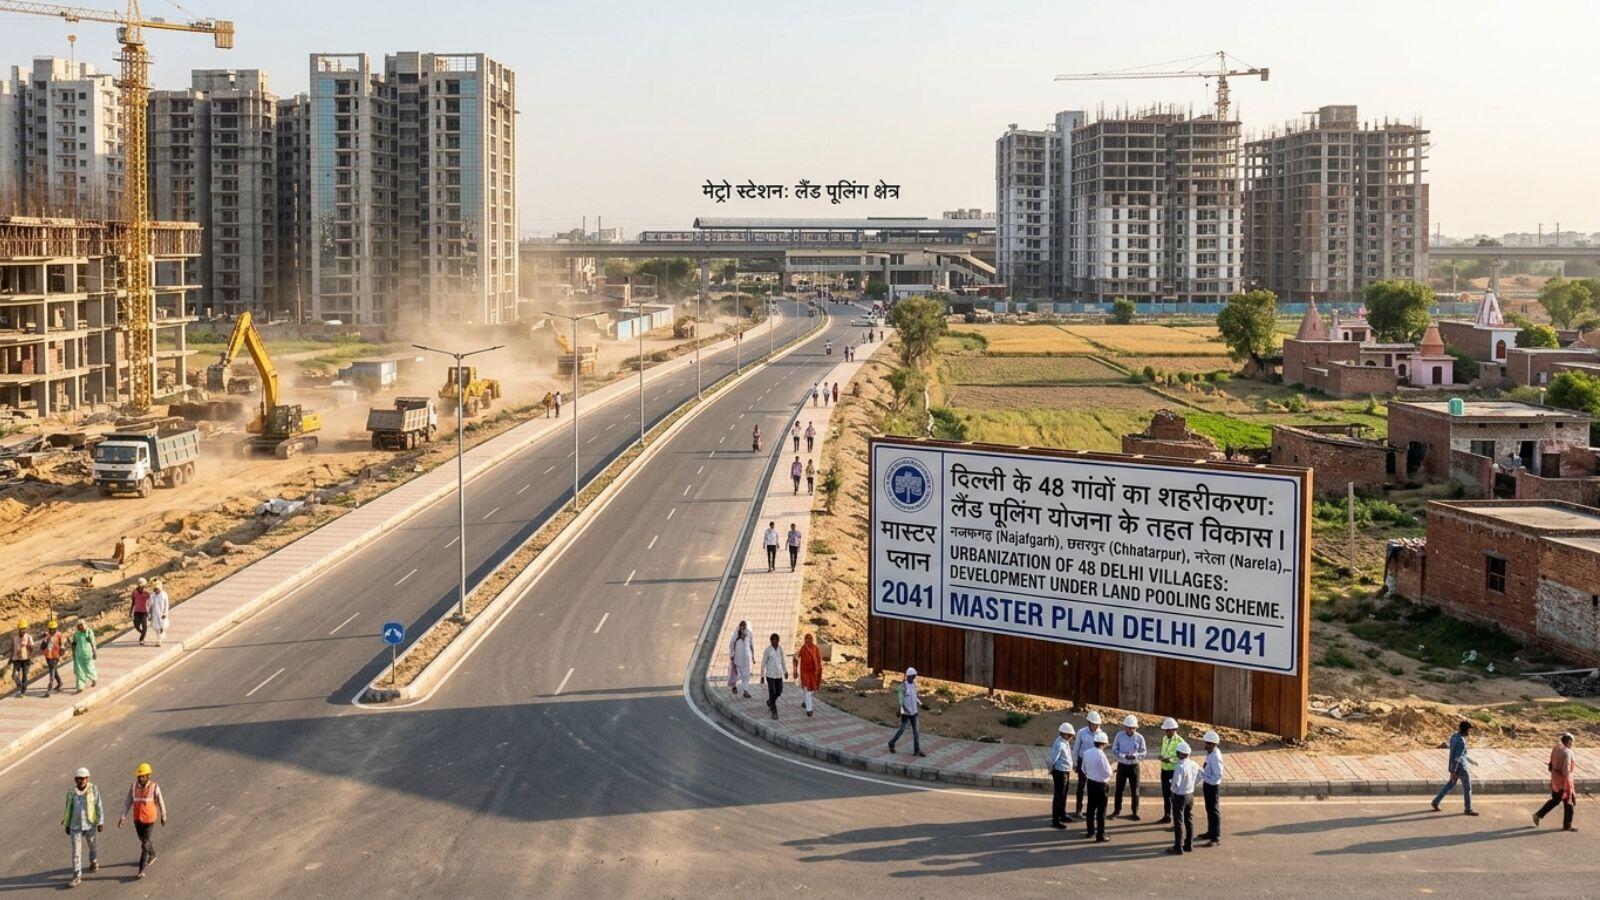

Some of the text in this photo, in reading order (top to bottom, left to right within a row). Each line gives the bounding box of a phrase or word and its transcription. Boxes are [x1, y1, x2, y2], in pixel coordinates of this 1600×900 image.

[1013, 468, 1032, 493] के
[1038, 477, 1064, 497] 48
[1071, 475, 1116, 502] गांवों
[1122, 484, 1151, 505] का
[1158, 483, 1274, 516] शहरीकरण:
[881, 521, 937, 543] मास्टर
[951, 492, 983, 518] लैंड
[989, 497, 1042, 528] पूलिंग
[1048, 502, 1112, 532] योजना
[1118, 508, 1140, 534] के
[1146, 517, 1193, 541] तहत
[1200, 516, 1273, 549] विकास
[886, 549, 932, 573] प्लान
[950, 545, 1228, 592] URBANIZATION OF 48 DELHI VILLAGES:
[996, 529, 1063, 550] (Najafgarh),
[1109, 541, 1190, 565] (Chhatarpur),
[882, 579, 933, 609] 2041
[950, 564, 1285, 620] DEVELOPMENT UNDER LAND POOLING SCHEME.
[950, 591, 1266, 657] MASTER PLAN DELHI 2041
